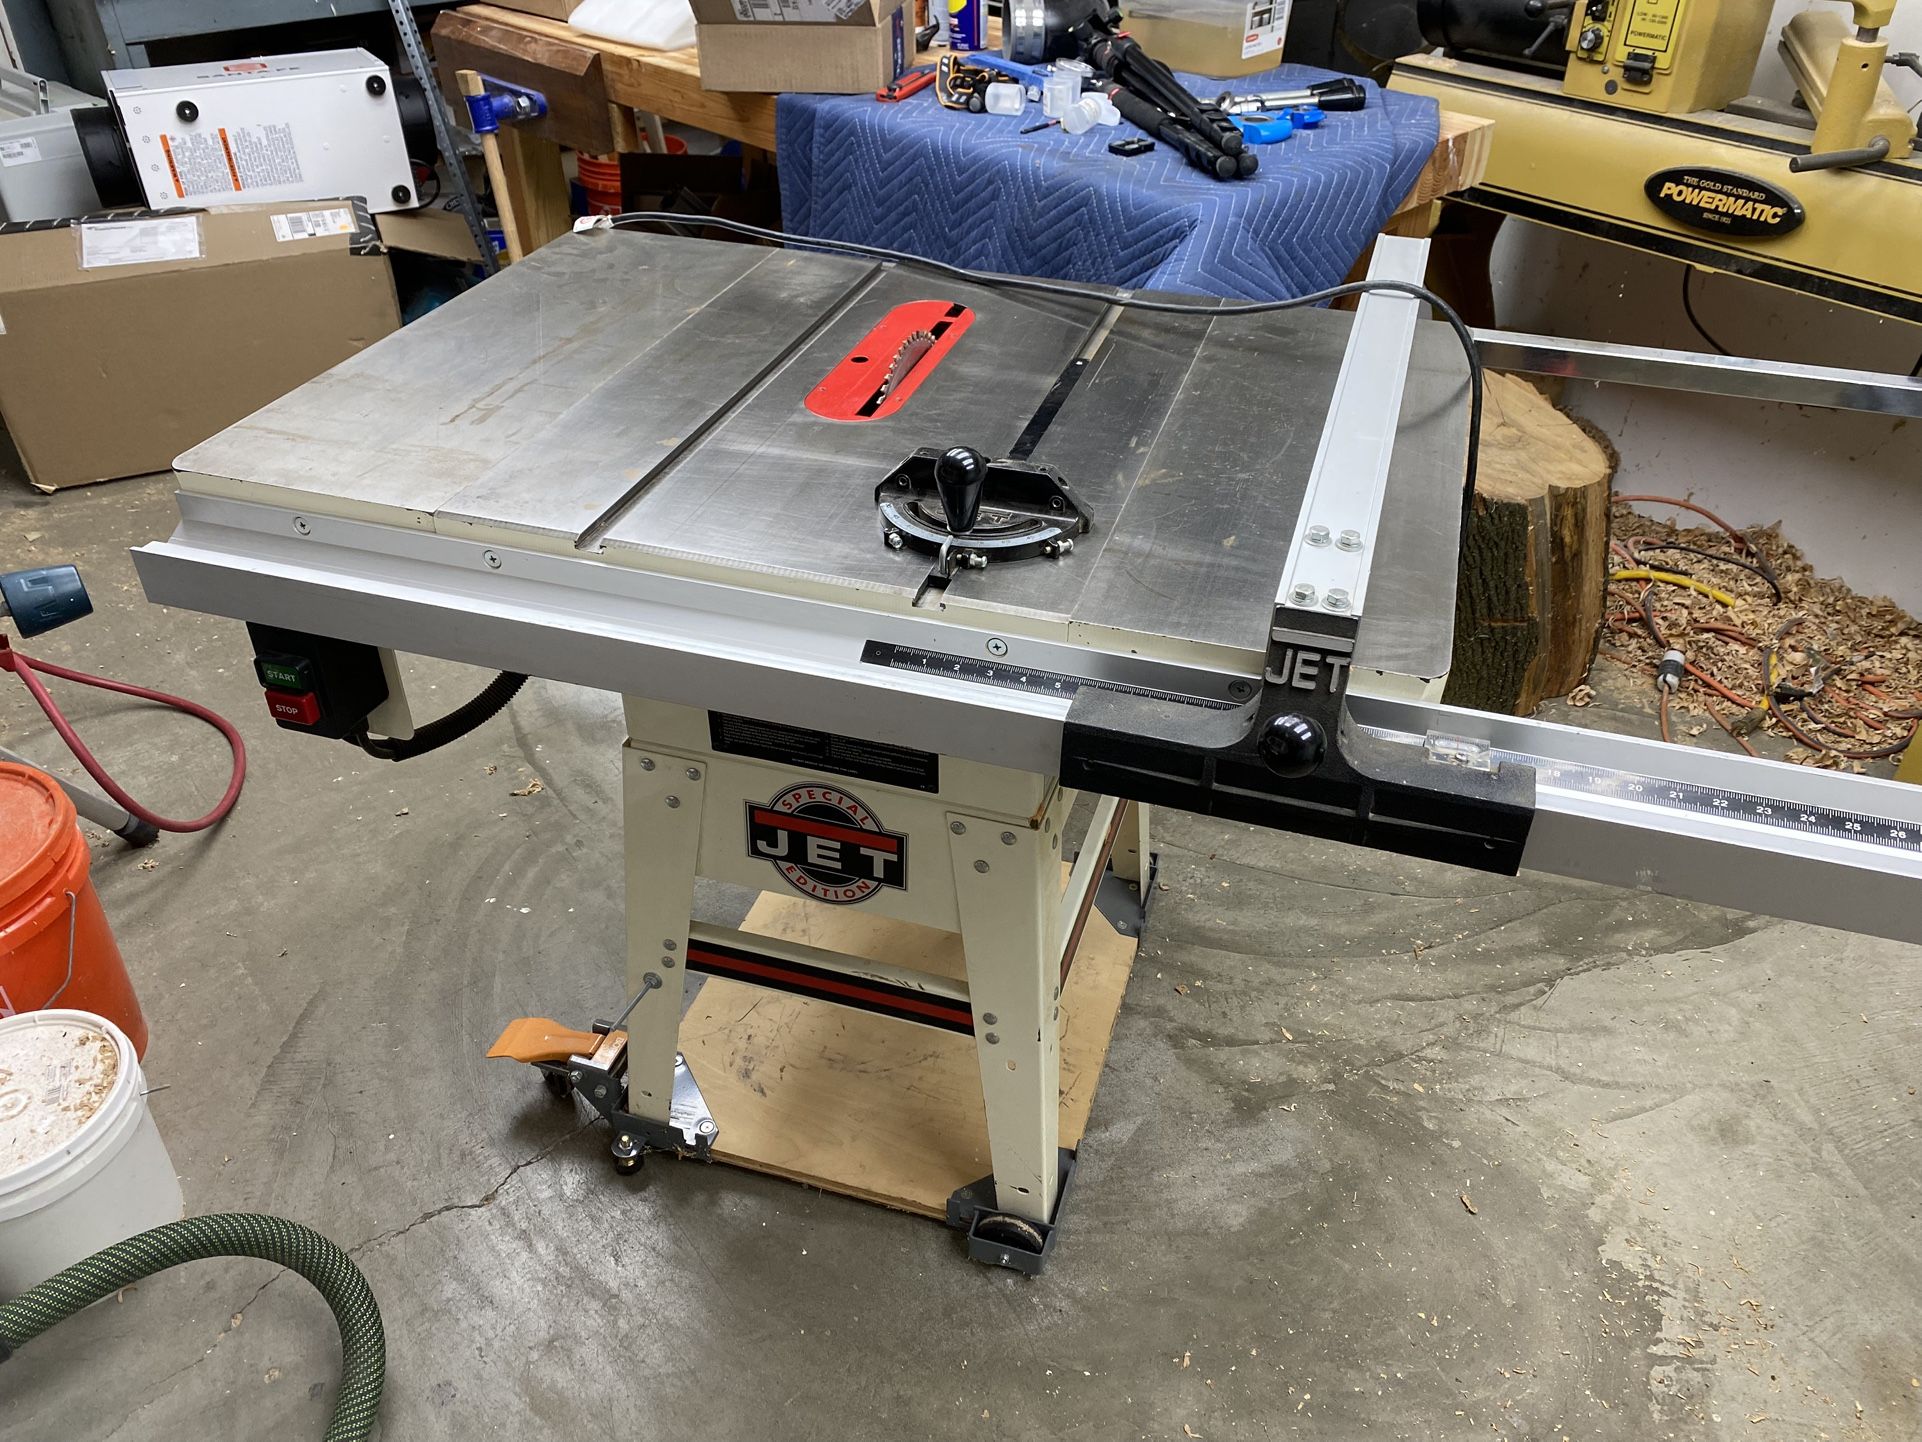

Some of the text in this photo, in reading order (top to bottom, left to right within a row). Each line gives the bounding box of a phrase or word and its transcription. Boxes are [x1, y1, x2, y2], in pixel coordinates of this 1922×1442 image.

[1660, 181, 1785, 225] POWERMATIC
[1683, 175, 1766, 201] THE GOLD STANDARD
[266, 670, 296, 682] START
[1265, 648, 1352, 693] JET
[275, 704, 299, 715] STOP
[781, 789, 870, 825] SPECIAL
[1548, 769, 1907, 839] 18 19 20 21 22 23 24 25 26
[756, 829, 898, 879] JET
[785, 864, 871, 899] EDITION
